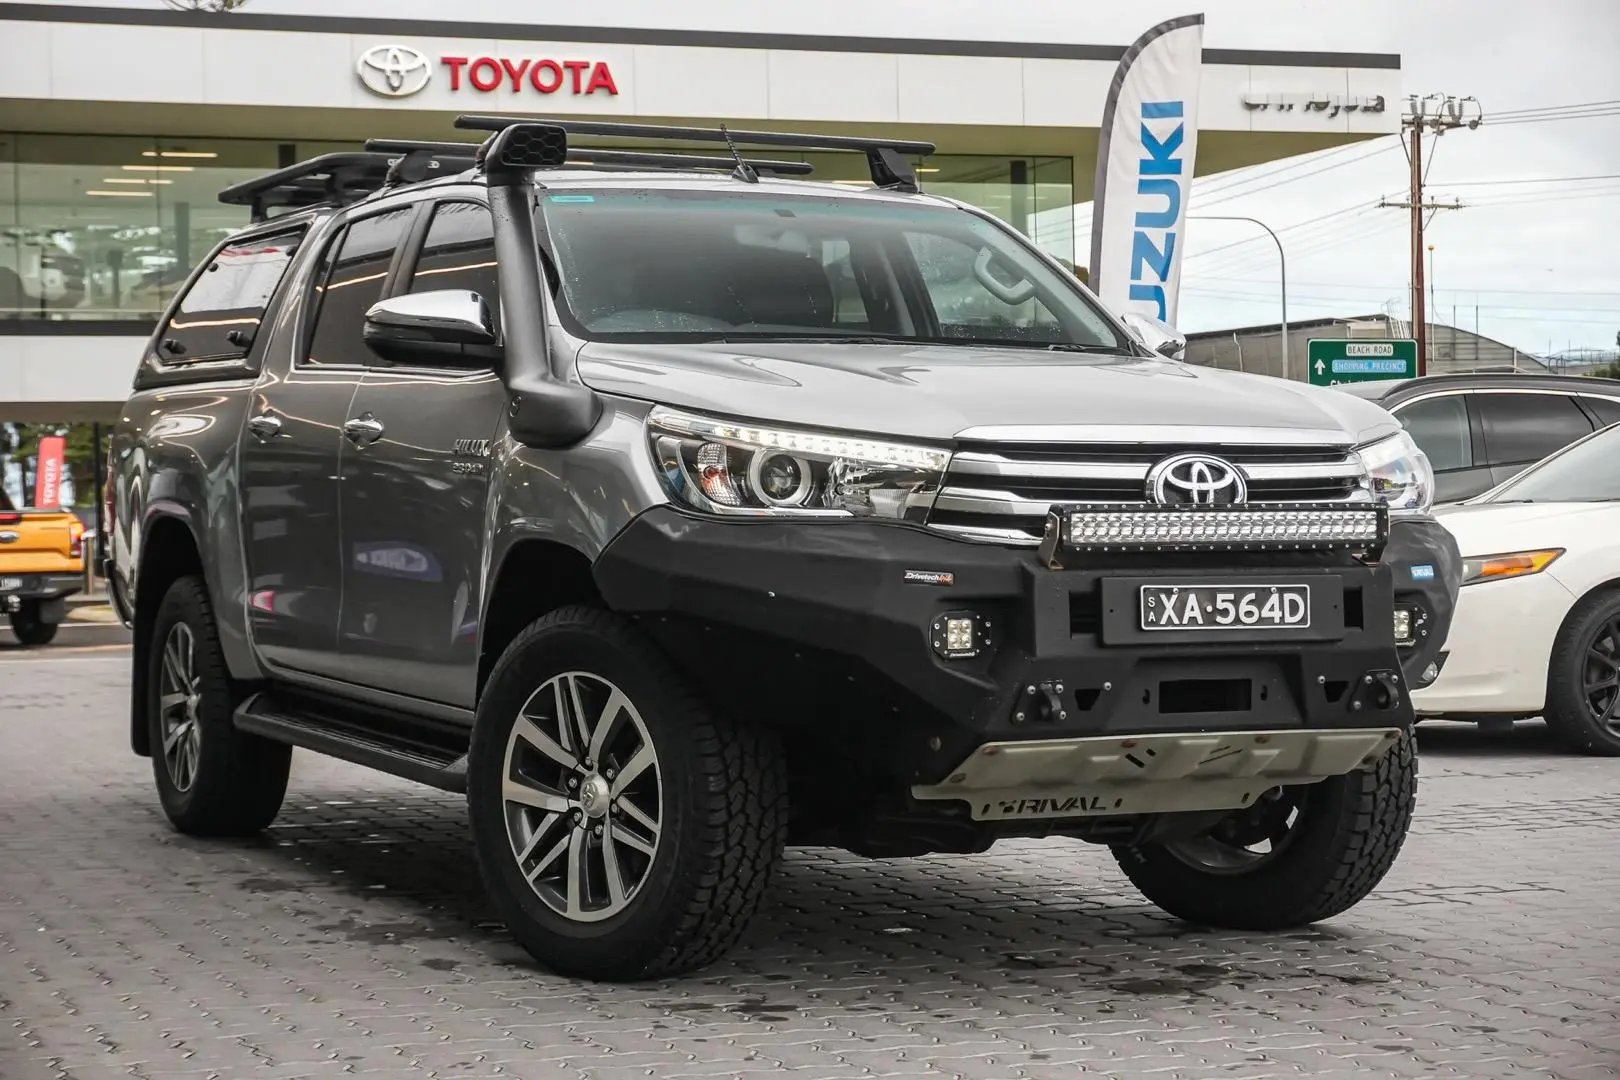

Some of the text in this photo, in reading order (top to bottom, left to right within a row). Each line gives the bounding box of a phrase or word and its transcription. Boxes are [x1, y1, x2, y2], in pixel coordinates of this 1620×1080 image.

[441, 56, 618, 95] TOYOTA
[1347, 345, 1392, 354] BEACH ROAD
[1373, 361, 1405, 371] PRECINCT
[43, 458, 58, 504] TOYOTA
[1016, 796, 1107, 814] RIVAL
